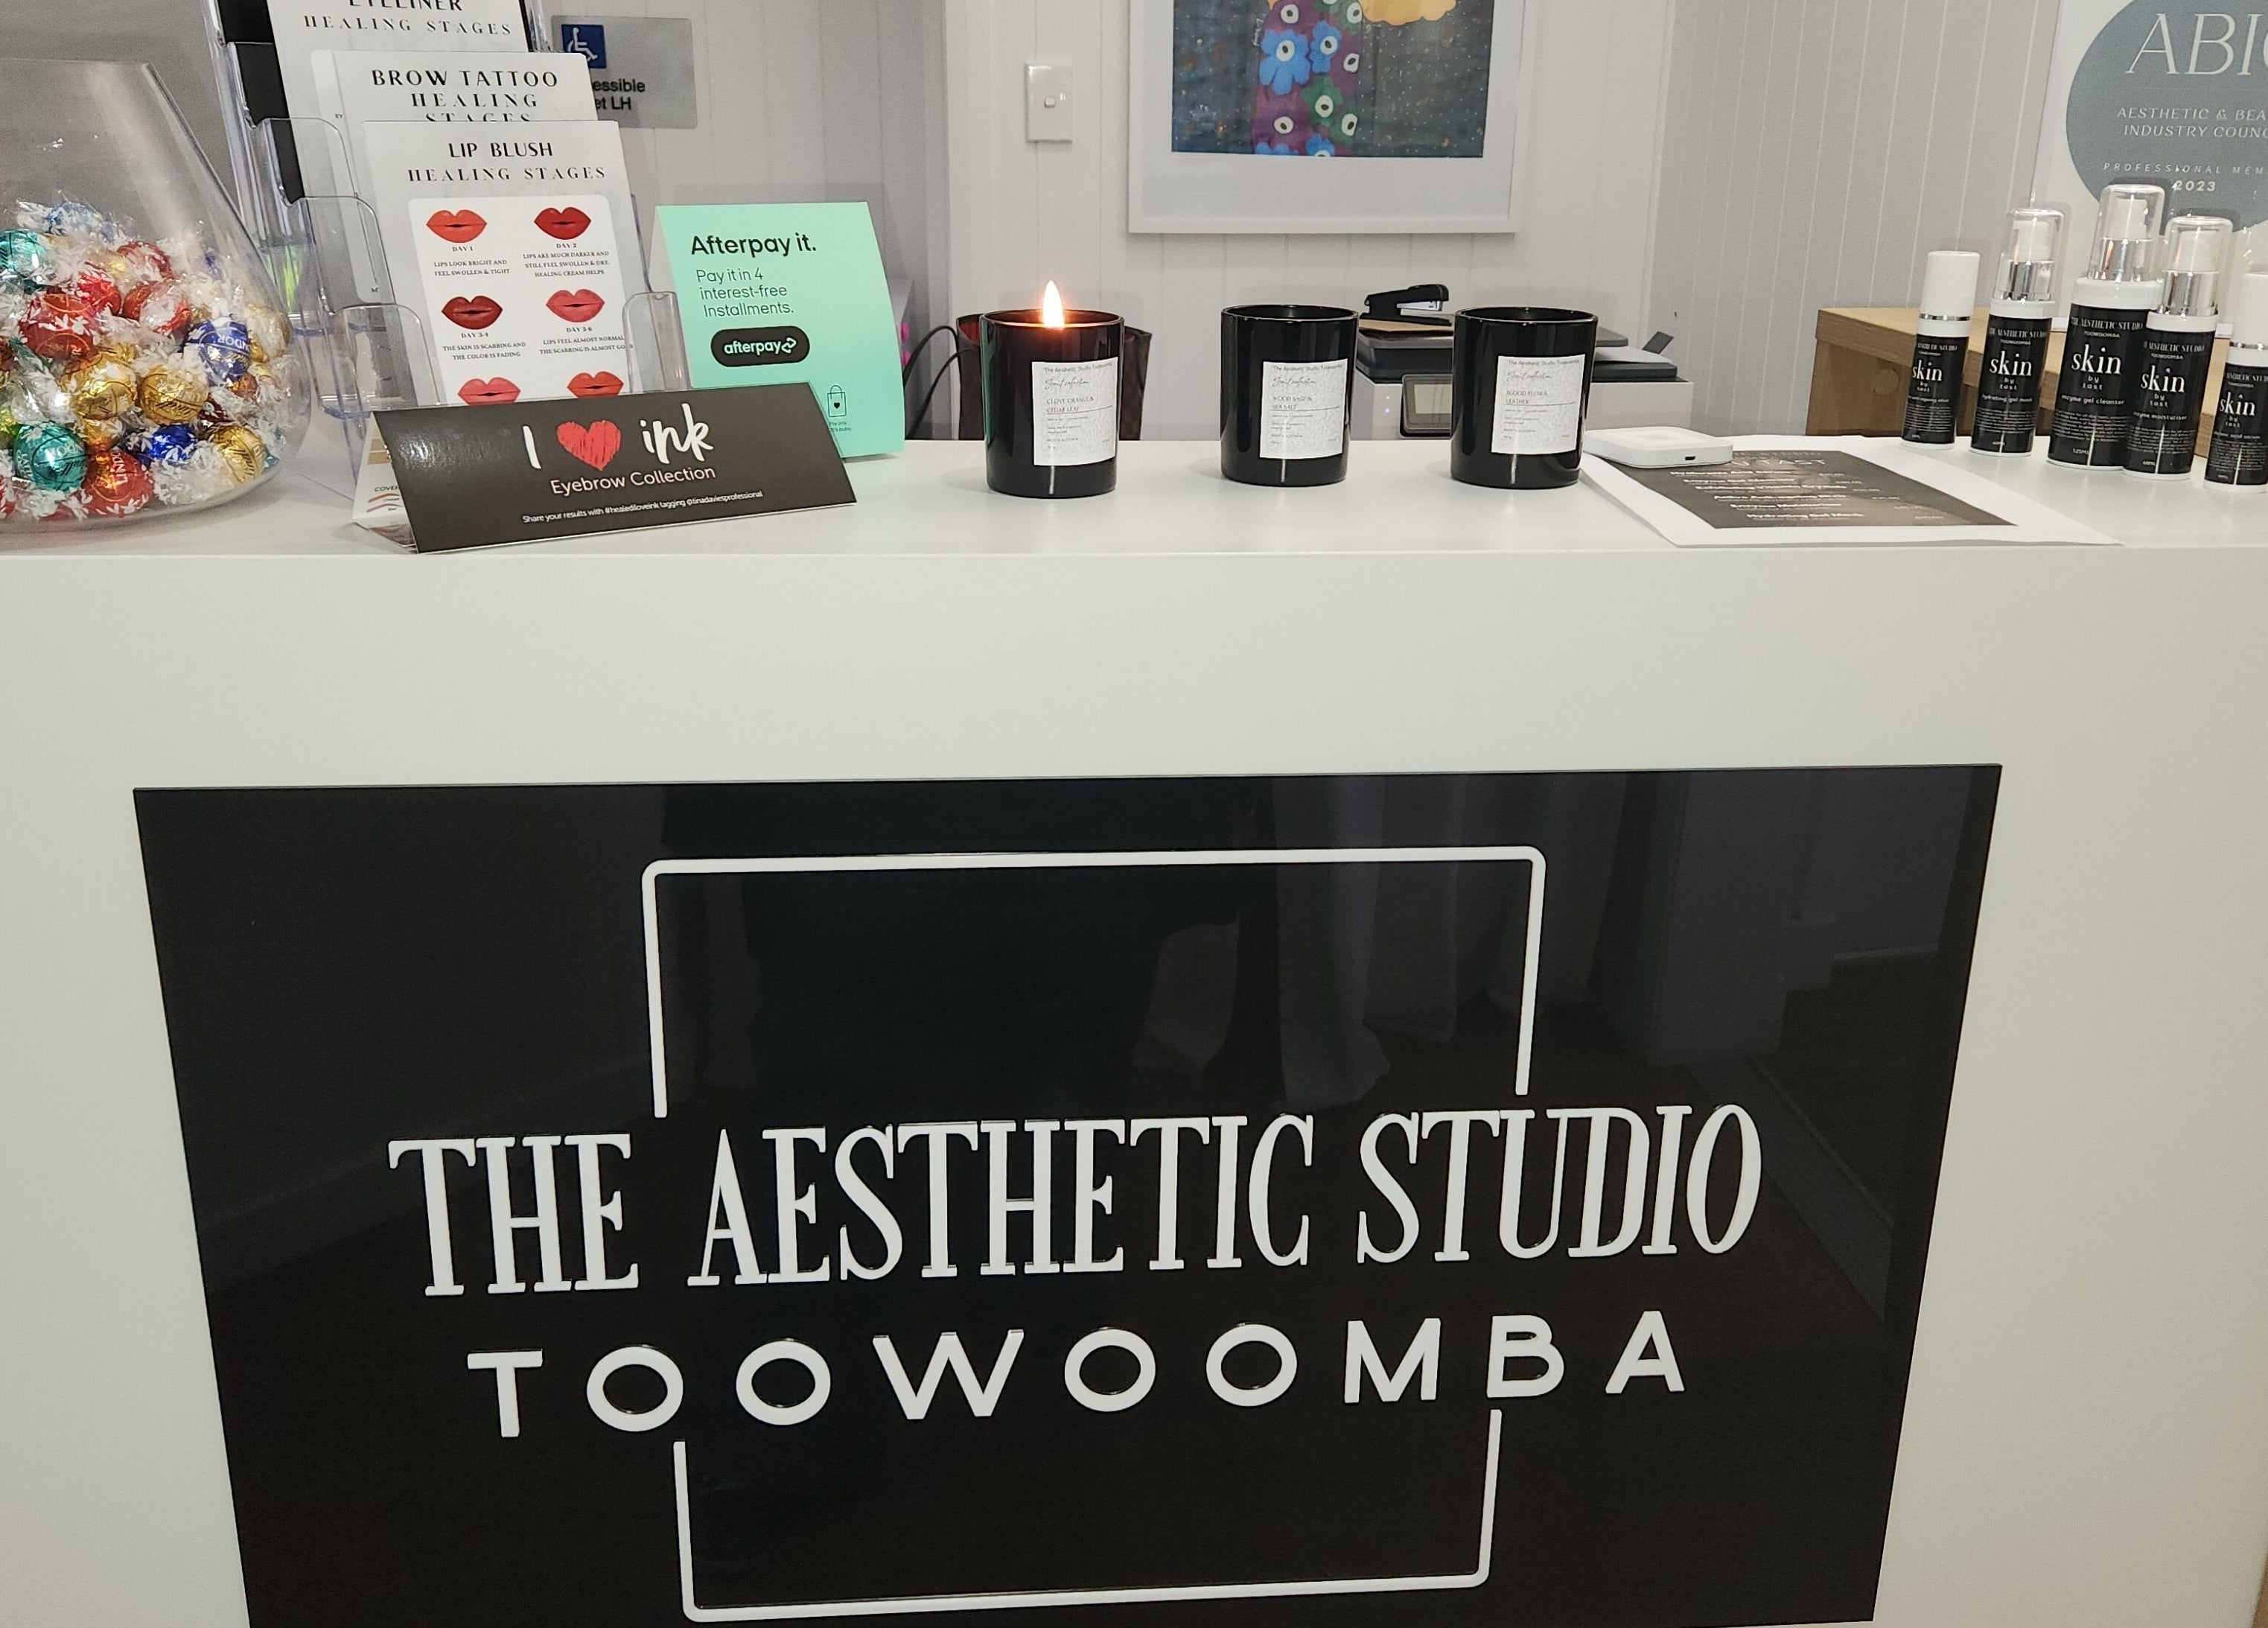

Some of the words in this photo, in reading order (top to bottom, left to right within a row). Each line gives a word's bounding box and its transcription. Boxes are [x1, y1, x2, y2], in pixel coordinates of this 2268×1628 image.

[303, 15, 411, 31] HEALING
[427, 20, 512, 36] STAGES
[2125, 13, 2268, 75] ABI
[372, 69, 447, 86] BROW
[459, 70, 558, 87] TATTOO
[592, 78, 645, 92] essible
[411, 93, 537, 107] HEALING
[611, 96, 631, 109] LH
[2117, 107, 2209, 120] AESTHETIC
[2216, 109, 2227, 120] &
[2235, 109, 2267, 121] BEA
[2124, 125, 2208, 137] INDUSTRY
[448, 142, 477, 157] LIP
[490, 142, 553, 157] BLUSH
[408, 168, 510, 182] HEALING
[524, 167, 605, 180] STAGES
[2103, 162, 2221, 174] PROFESSIONAL
[2232, 166, 2268, 175] MEM
[2173, 180, 2215, 191] 2023
[691, 233, 791, 258] Afterpay
[794, 232, 816, 252] it.
[695, 269, 724, 284] Pay
[727, 268, 737, 282] it
[739, 267, 751, 281] in
[754, 267, 763, 280] 4
[700, 285, 788, 300] interest-free
[704, 302, 794, 317] Installments.
[724, 340, 782, 356] afterpay
[1990, 350, 2032, 376] skin
[2071, 344, 2121, 375] skin
[1912, 360, 1943, 381] skin
[2141, 365, 2185, 392] skin
[2219, 392, 2255, 416] skin
[522, 424, 542, 469] I
[641, 403, 714, 465] ink
[550, 474, 625, 497] Eyebrow
[630, 466, 716, 486] Collection
[523, 514, 544, 523] Share
[545, 512, 562, 521] your
[564, 509, 587, 519] results
[587, 507, 604, 515] with
[660, 498, 686, 509] tagging
[387, 1133, 639, 1296] THE
[687, 1113, 1314, 1286] AESTHETIC
[1357, 1103, 1762, 1264] STUDIO
[467, 1309, 1686, 1438] TOOWOOMBA
